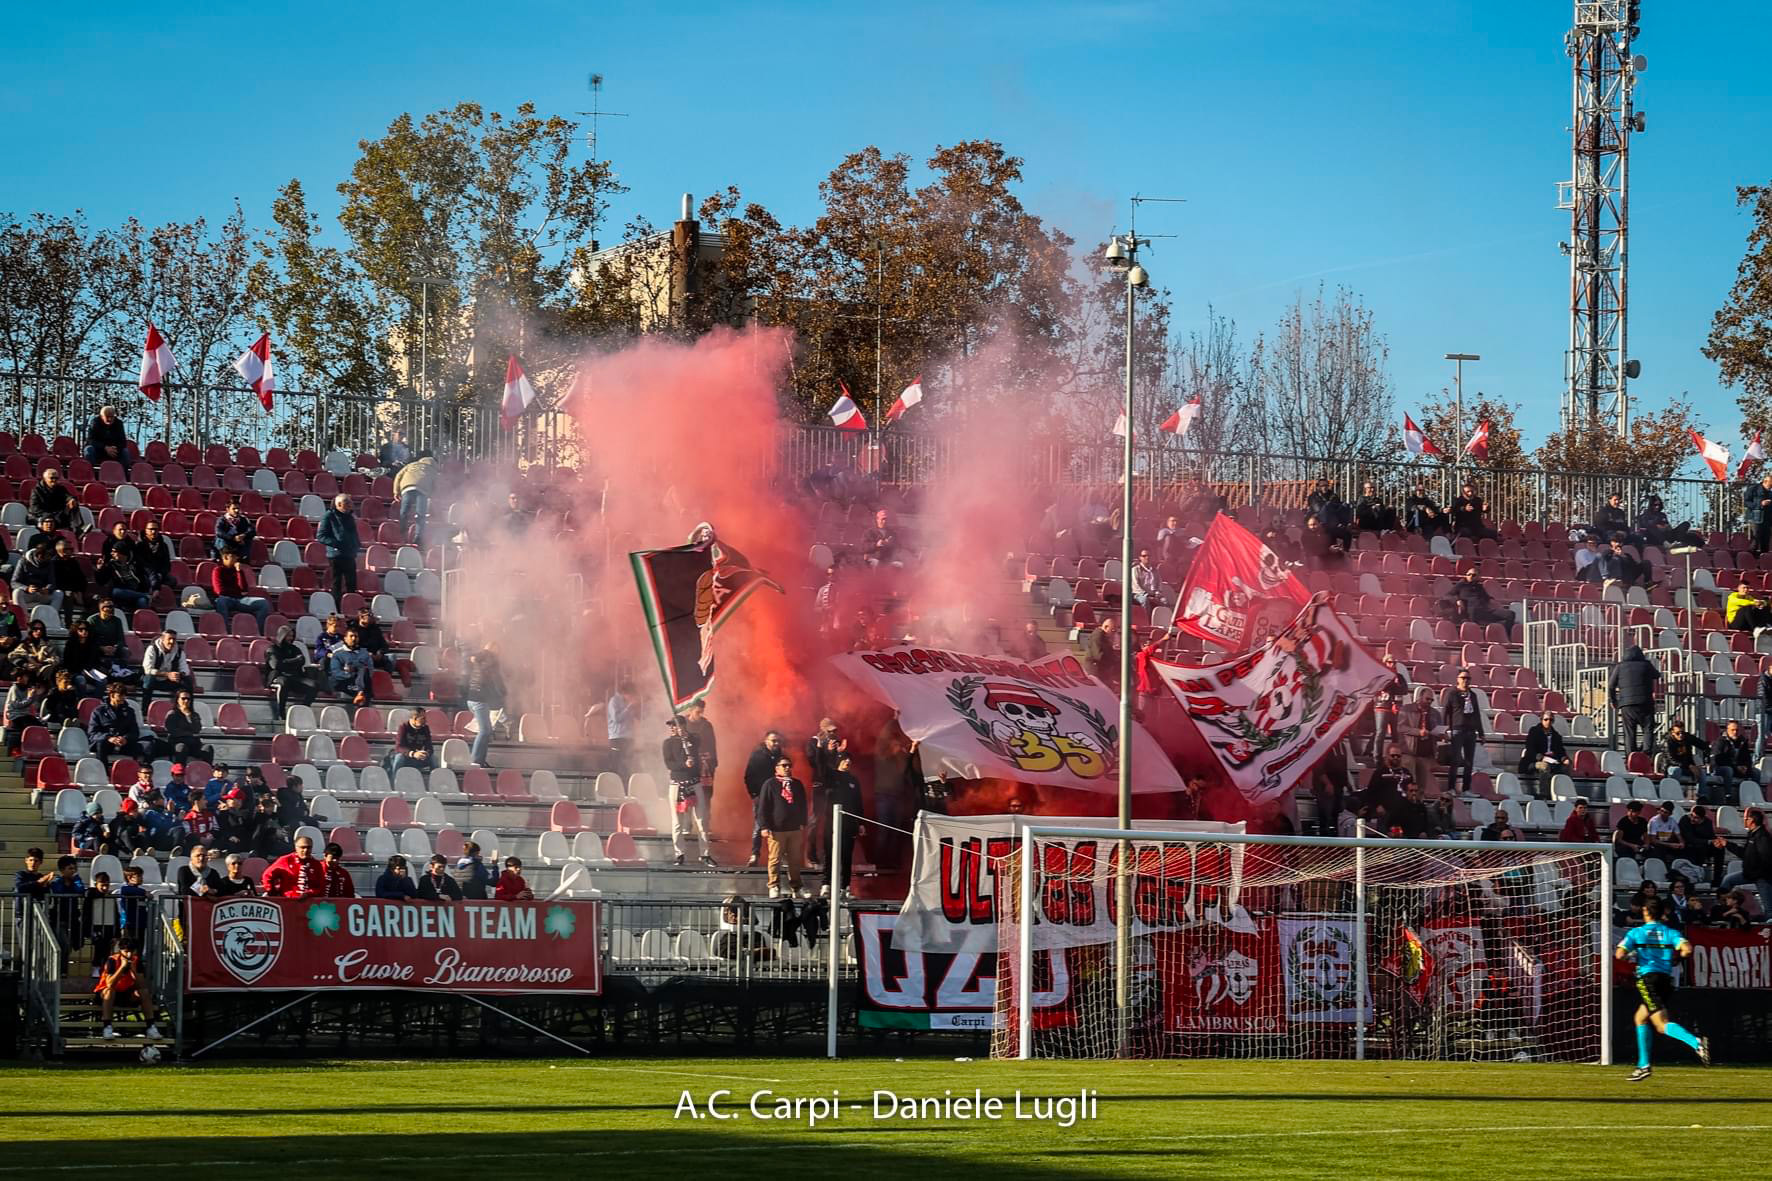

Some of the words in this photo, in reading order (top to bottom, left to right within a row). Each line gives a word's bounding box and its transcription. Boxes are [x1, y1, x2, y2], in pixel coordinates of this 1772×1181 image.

[1008, 729, 1106, 780] 35
[940, 836, 1096, 926] ULTRAS
[219, 906, 239, 921] A.C.
[241, 905, 275, 921] CARPI
[347, 903, 456, 939] GARDEN
[464, 906, 537, 941] TEAM
[423, 946, 574, 985] Biancorosso
[951, 1015, 986, 1029] Carpi
[1175, 1015, 1276, 1031] LAMBRUSCO
